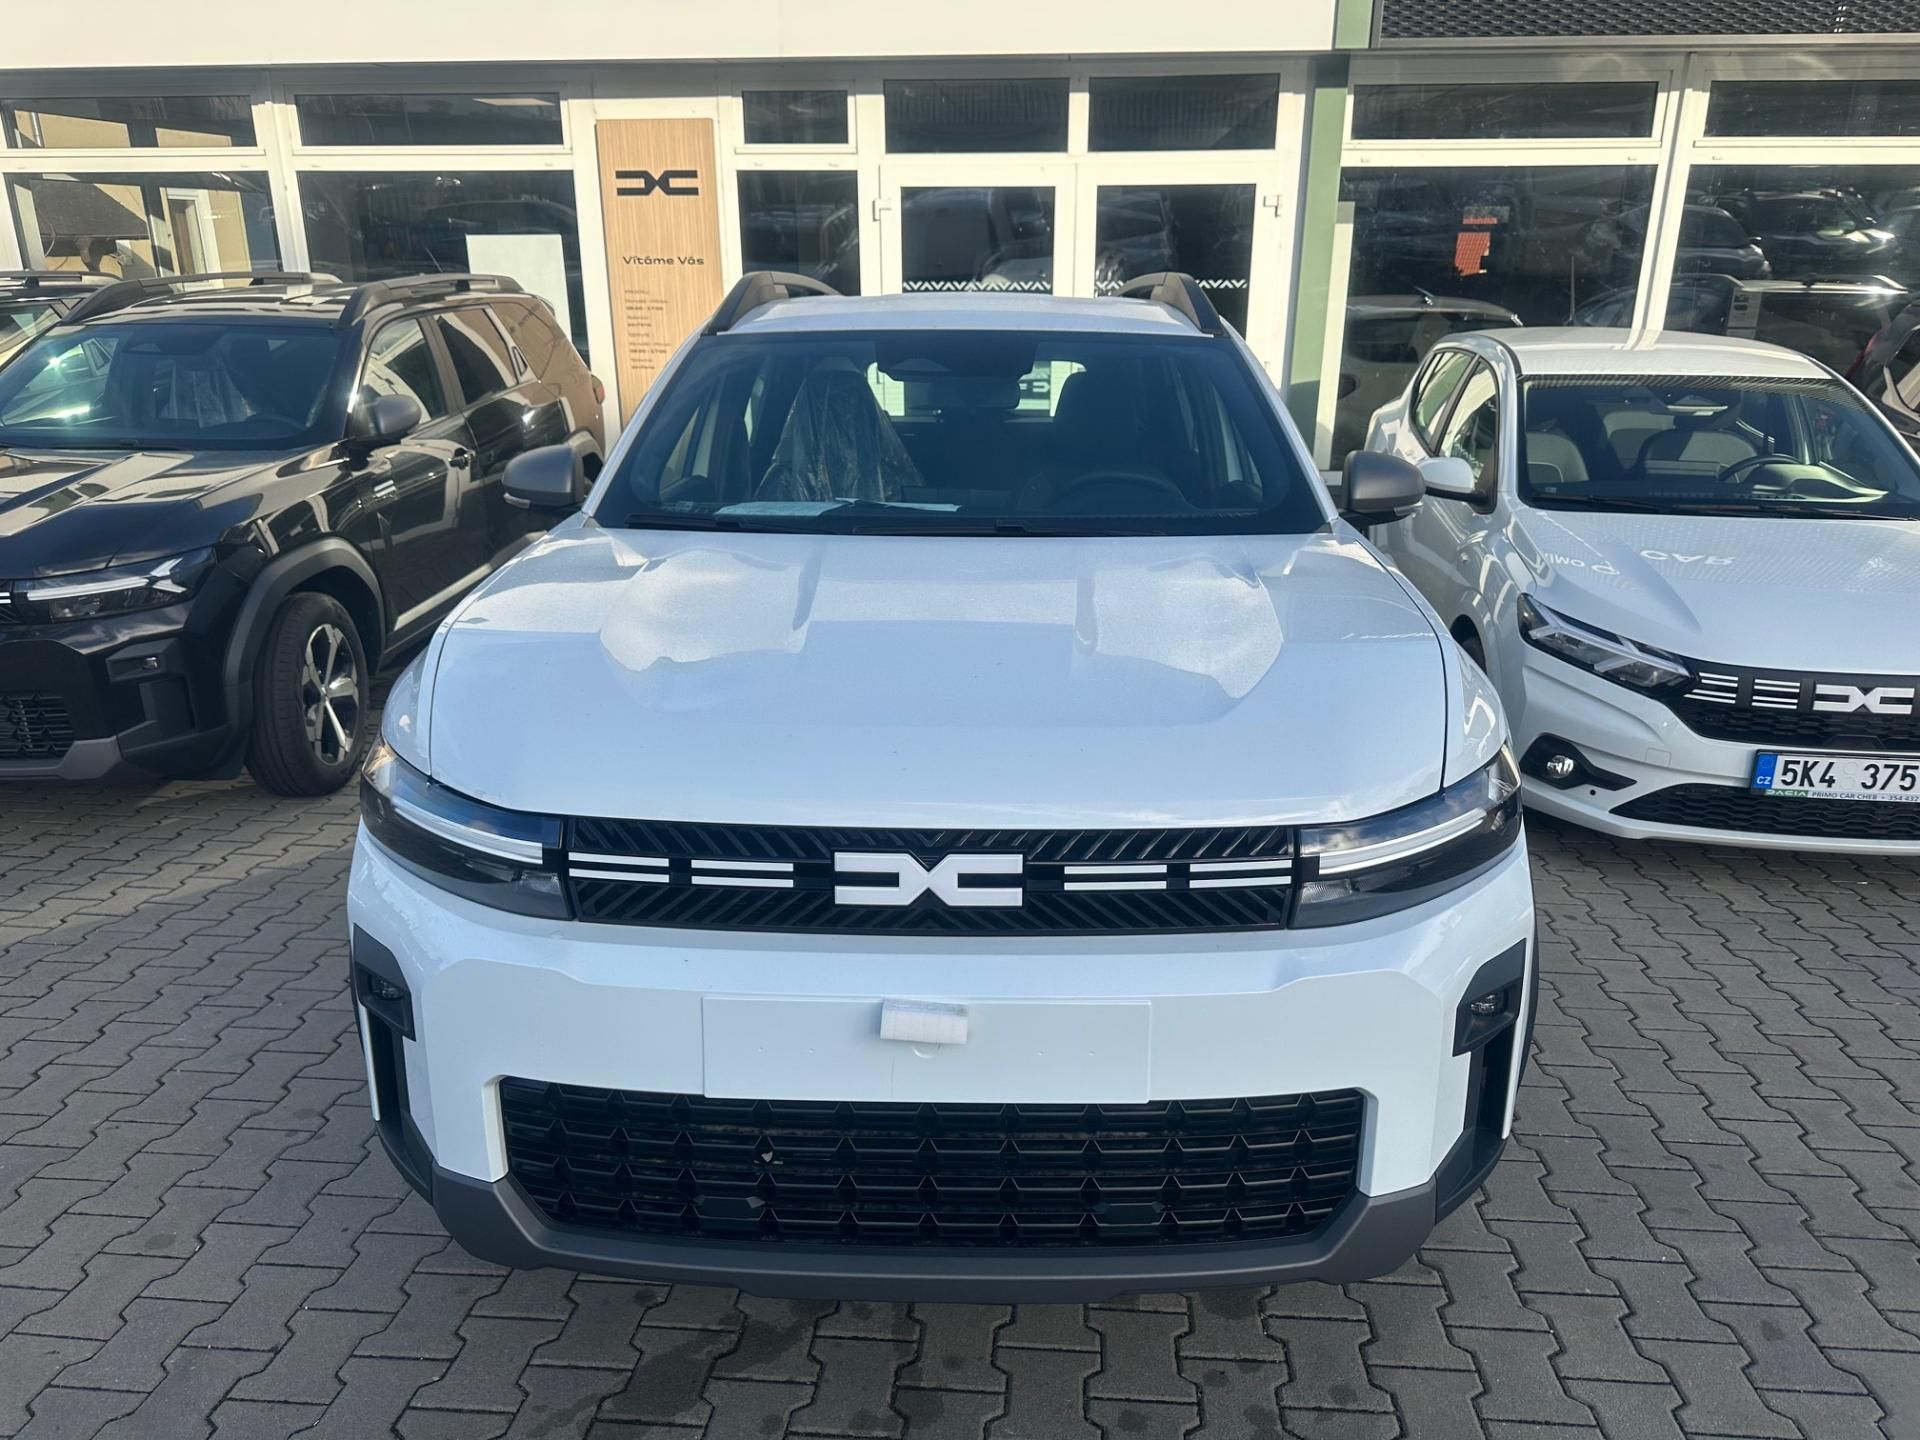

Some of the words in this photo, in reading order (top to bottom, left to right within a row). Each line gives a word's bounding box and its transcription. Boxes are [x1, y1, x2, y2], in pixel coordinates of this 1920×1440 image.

[677, 256, 704, 265] Vás
[1756, 775, 1772, 785] CZ
[1780, 760, 1836, 788] 5K4
[1861, 763, 1919, 791] 375
[1765, 789, 1807, 797] DACIA
[1812, 791, 1838, 799] PRIMO
